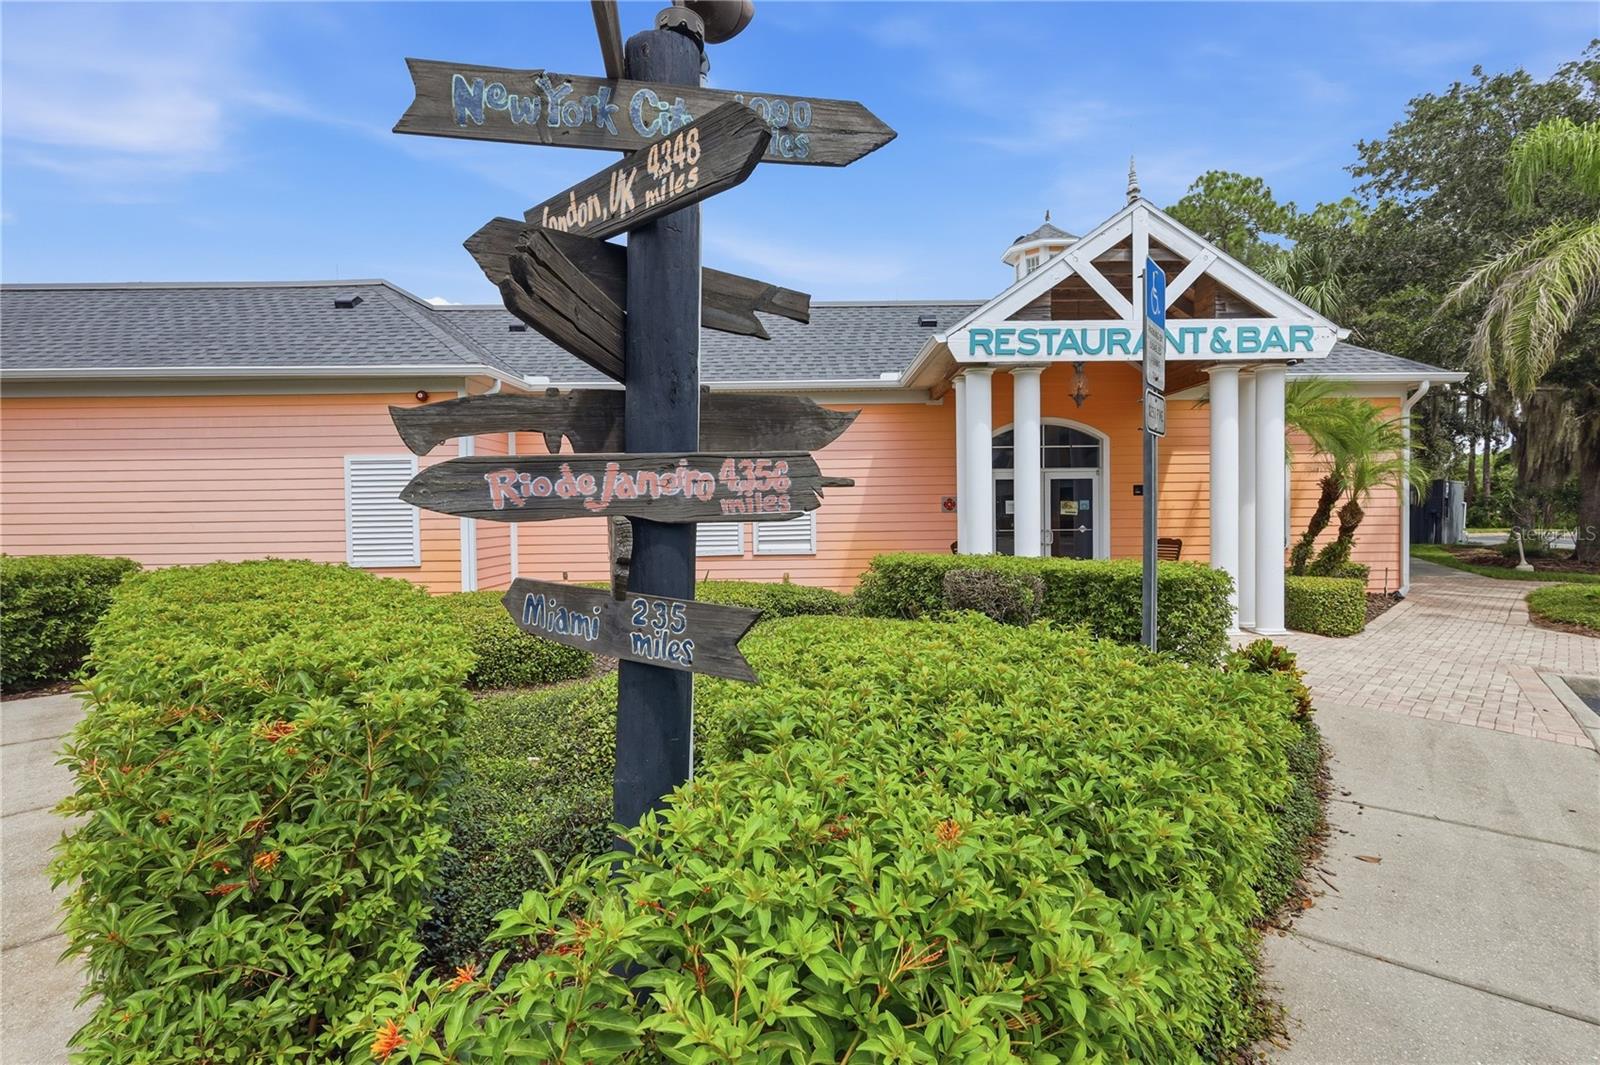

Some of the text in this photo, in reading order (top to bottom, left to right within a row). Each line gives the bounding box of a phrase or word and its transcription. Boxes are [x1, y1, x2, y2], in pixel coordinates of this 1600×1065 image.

[452, 71, 694, 138] New York Cit
[645, 166, 699, 209] miles
[1236, 324, 1314, 354] BAR
[484, 458, 715, 512] Rio de Janeiro
[719, 491, 792, 514] miles
[522, 592, 601, 642] Miami
[631, 597, 687, 634] 235
[629, 629, 695, 666] miles
